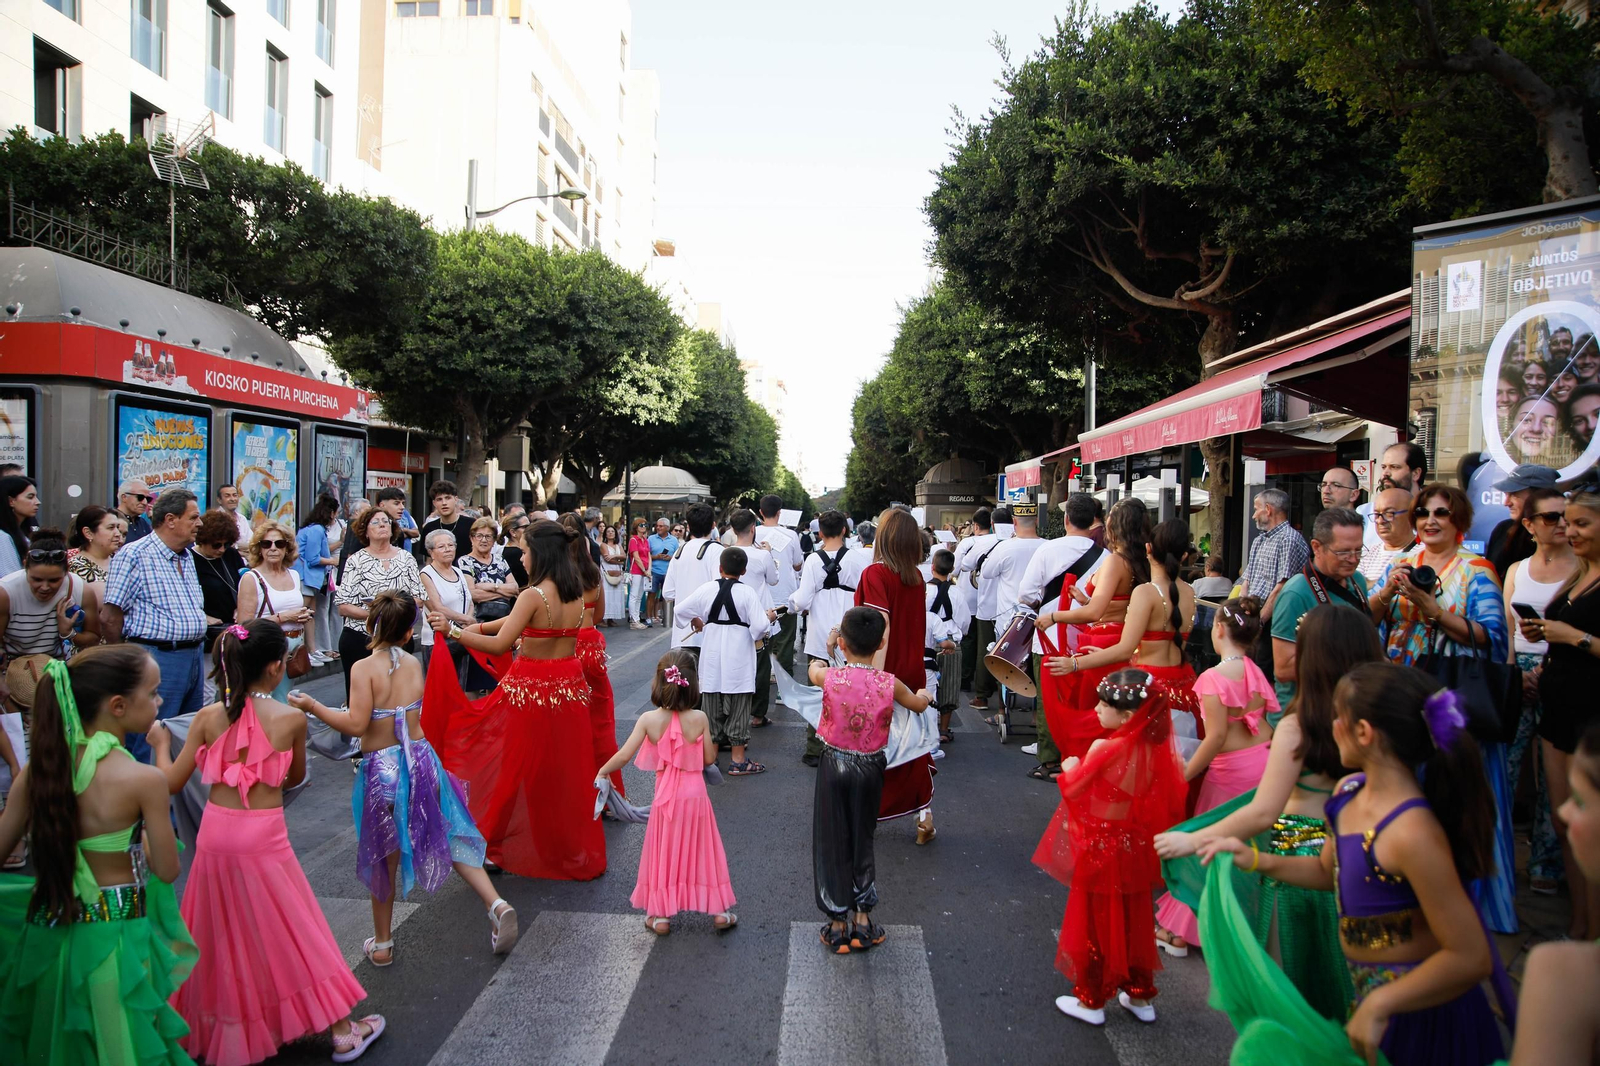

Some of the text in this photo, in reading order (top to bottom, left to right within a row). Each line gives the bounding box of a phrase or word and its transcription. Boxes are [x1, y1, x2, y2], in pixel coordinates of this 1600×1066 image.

[1521, 219, 1583, 237] JCDecaux
[1527, 249, 1579, 268] JUNTOS
[1513, 269, 1592, 293] OBJETIVO
[205, 369, 340, 410] KIOSKO PUERTA PURCHENA
[155, 417, 195, 435] NUEVAS
[162, 469, 188, 483] PARK
[1309, 576, 1321, 592] EOS
